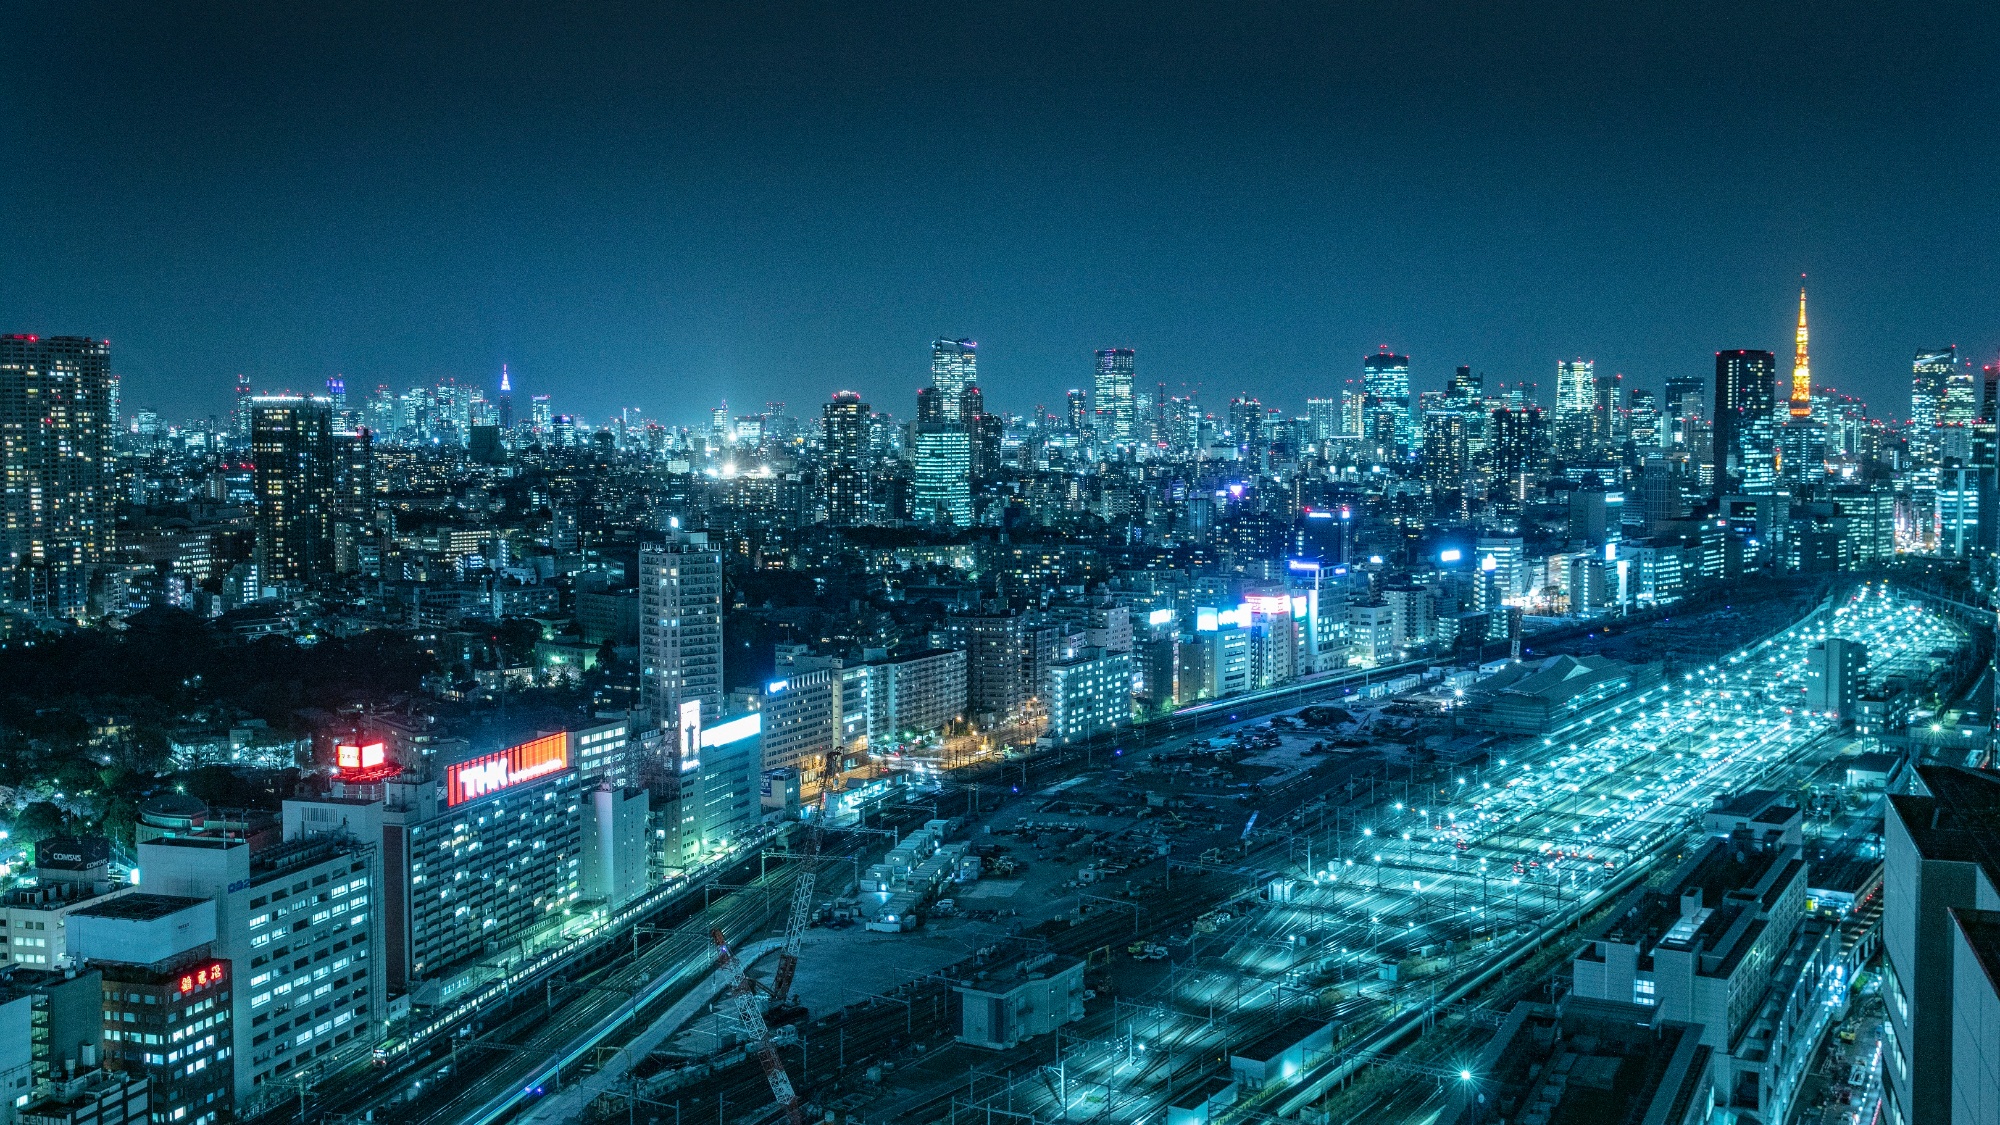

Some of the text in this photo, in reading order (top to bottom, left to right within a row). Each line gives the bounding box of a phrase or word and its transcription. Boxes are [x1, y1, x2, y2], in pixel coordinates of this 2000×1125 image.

[459, 757, 508, 796] THK
[53, 852, 82, 862] COMSYS
[86, 857, 108, 869] COMSYS
